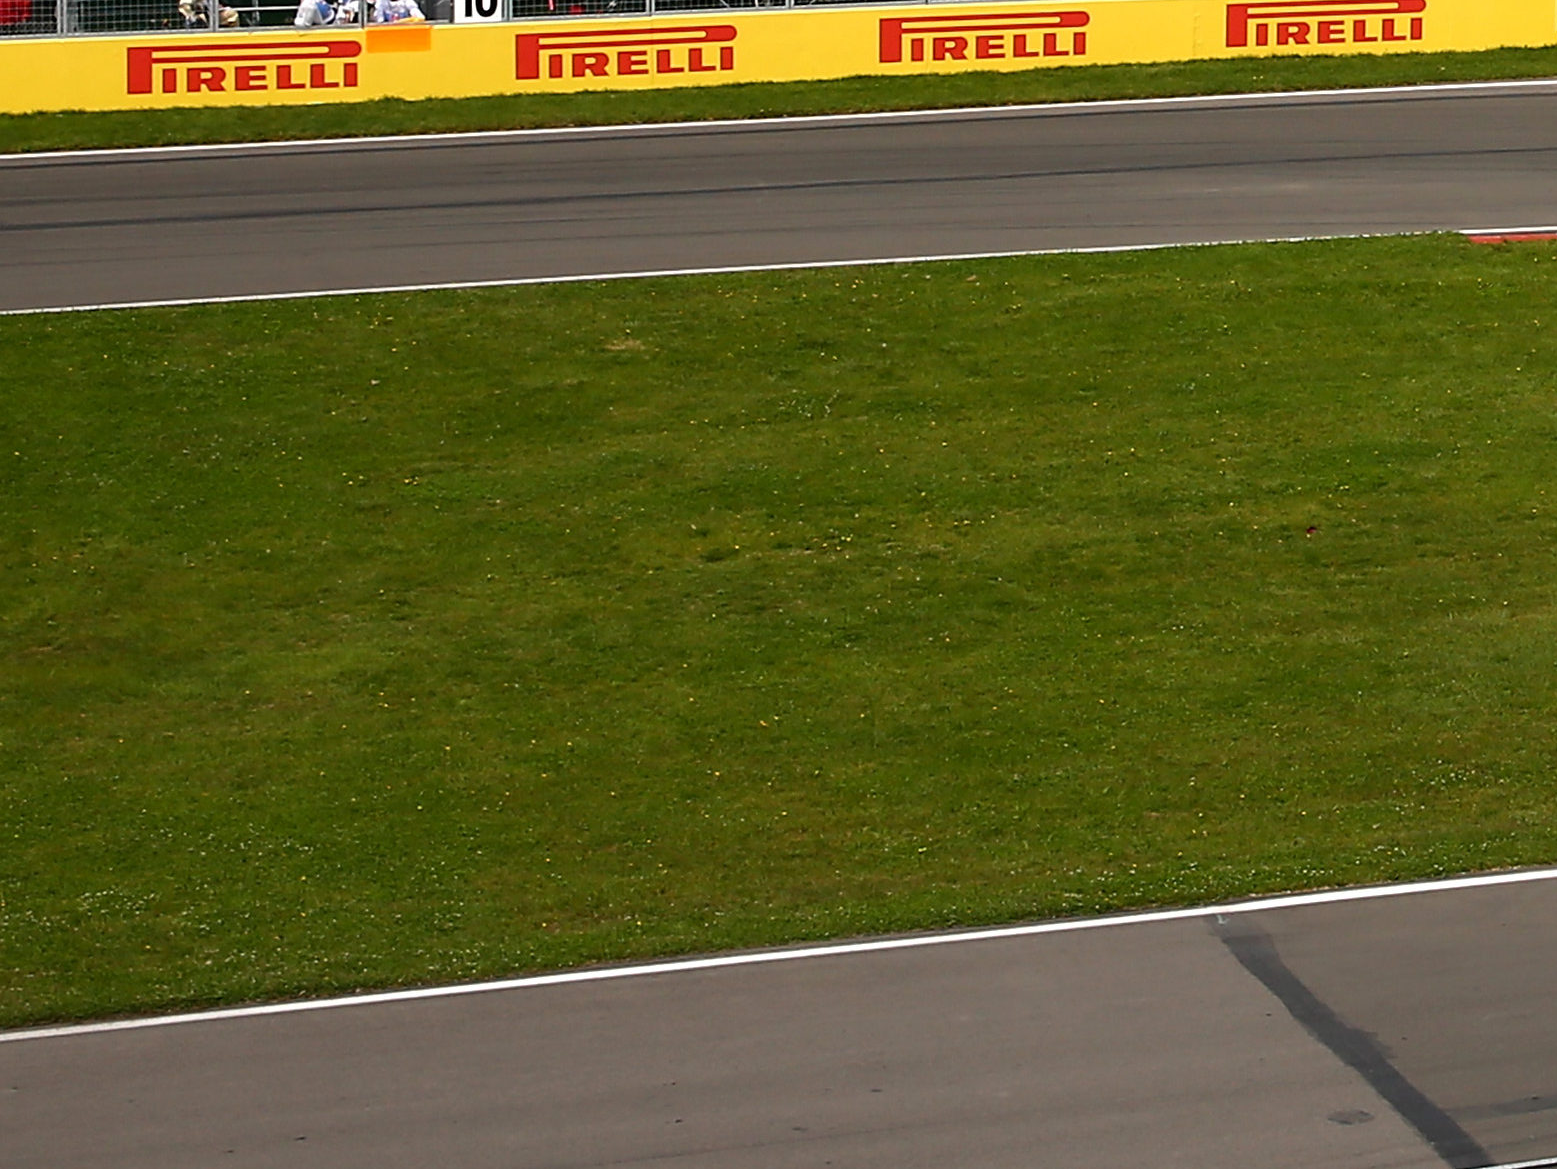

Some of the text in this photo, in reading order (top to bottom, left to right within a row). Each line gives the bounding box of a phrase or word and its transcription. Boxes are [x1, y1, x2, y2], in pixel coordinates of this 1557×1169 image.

[516, 25, 736, 79] PIRELLI
[880, 12, 1089, 62] PIRELLI
[128, 41, 361, 94] PIRELLI
